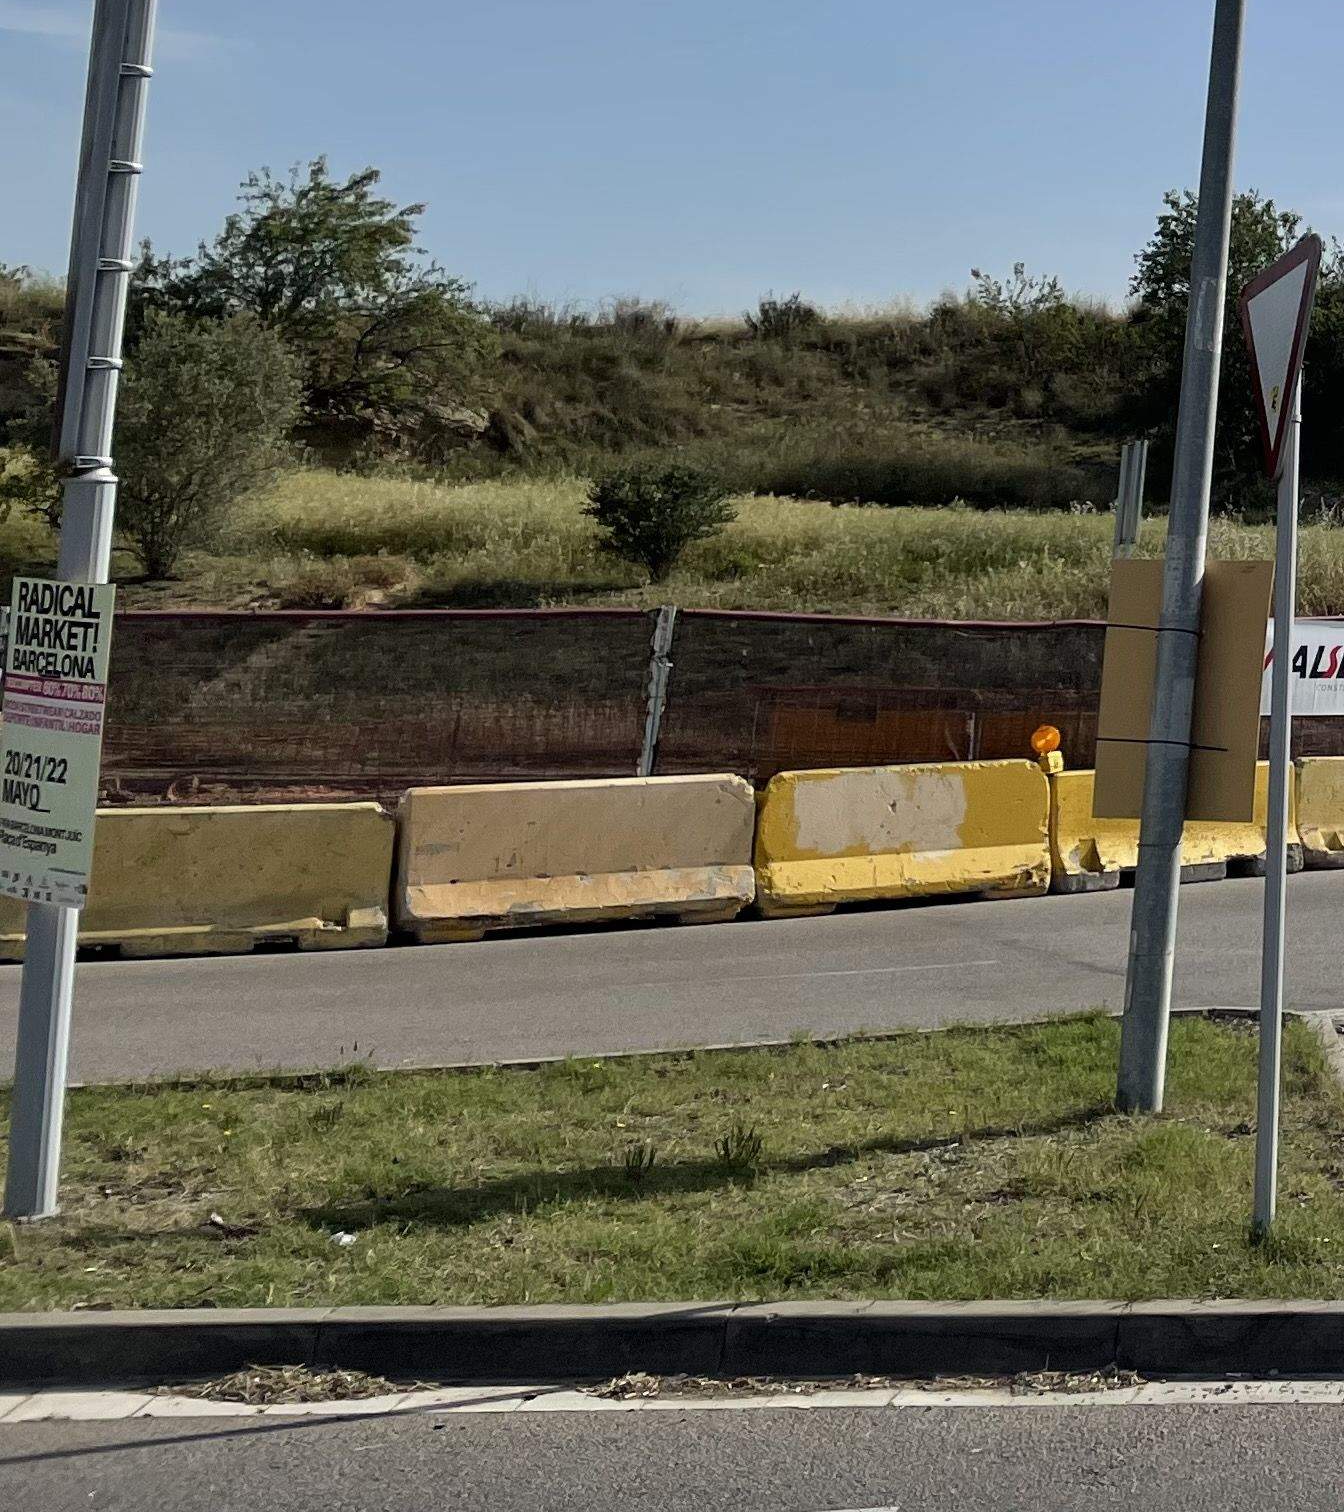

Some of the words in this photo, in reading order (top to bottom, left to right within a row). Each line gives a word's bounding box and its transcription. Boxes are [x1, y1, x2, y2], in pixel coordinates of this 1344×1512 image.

[17, 581, 101, 619] RADICAL
[15, 614, 99, 653] MARKET!
[12, 647, 96, 680] BARCELONA
[4, 749, 68, 785] 20/21/22
[2, 778, 41, 810] MAYO
